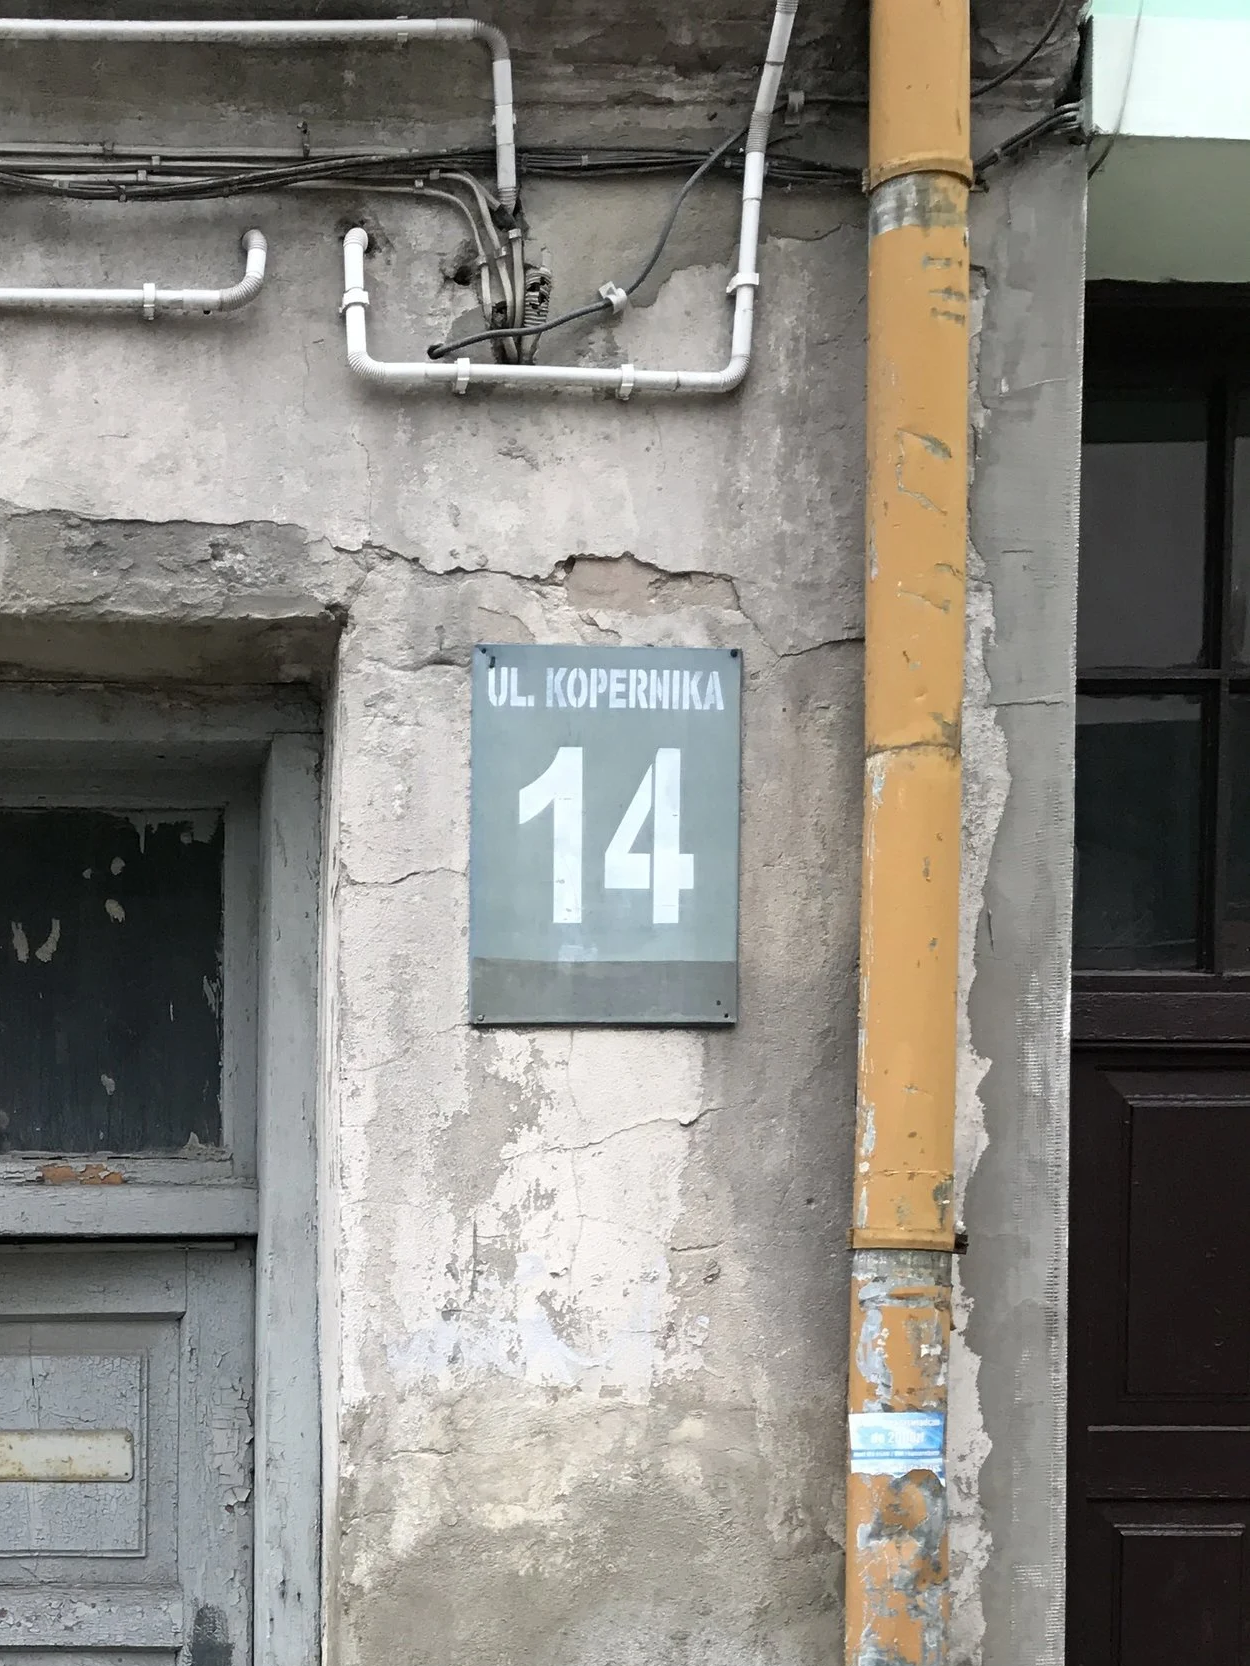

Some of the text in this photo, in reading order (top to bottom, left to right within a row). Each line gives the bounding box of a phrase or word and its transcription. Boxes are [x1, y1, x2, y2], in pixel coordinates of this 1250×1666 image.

[488, 666, 725, 711] UL. KOPERNIKA
[519, 746, 694, 924] 14
